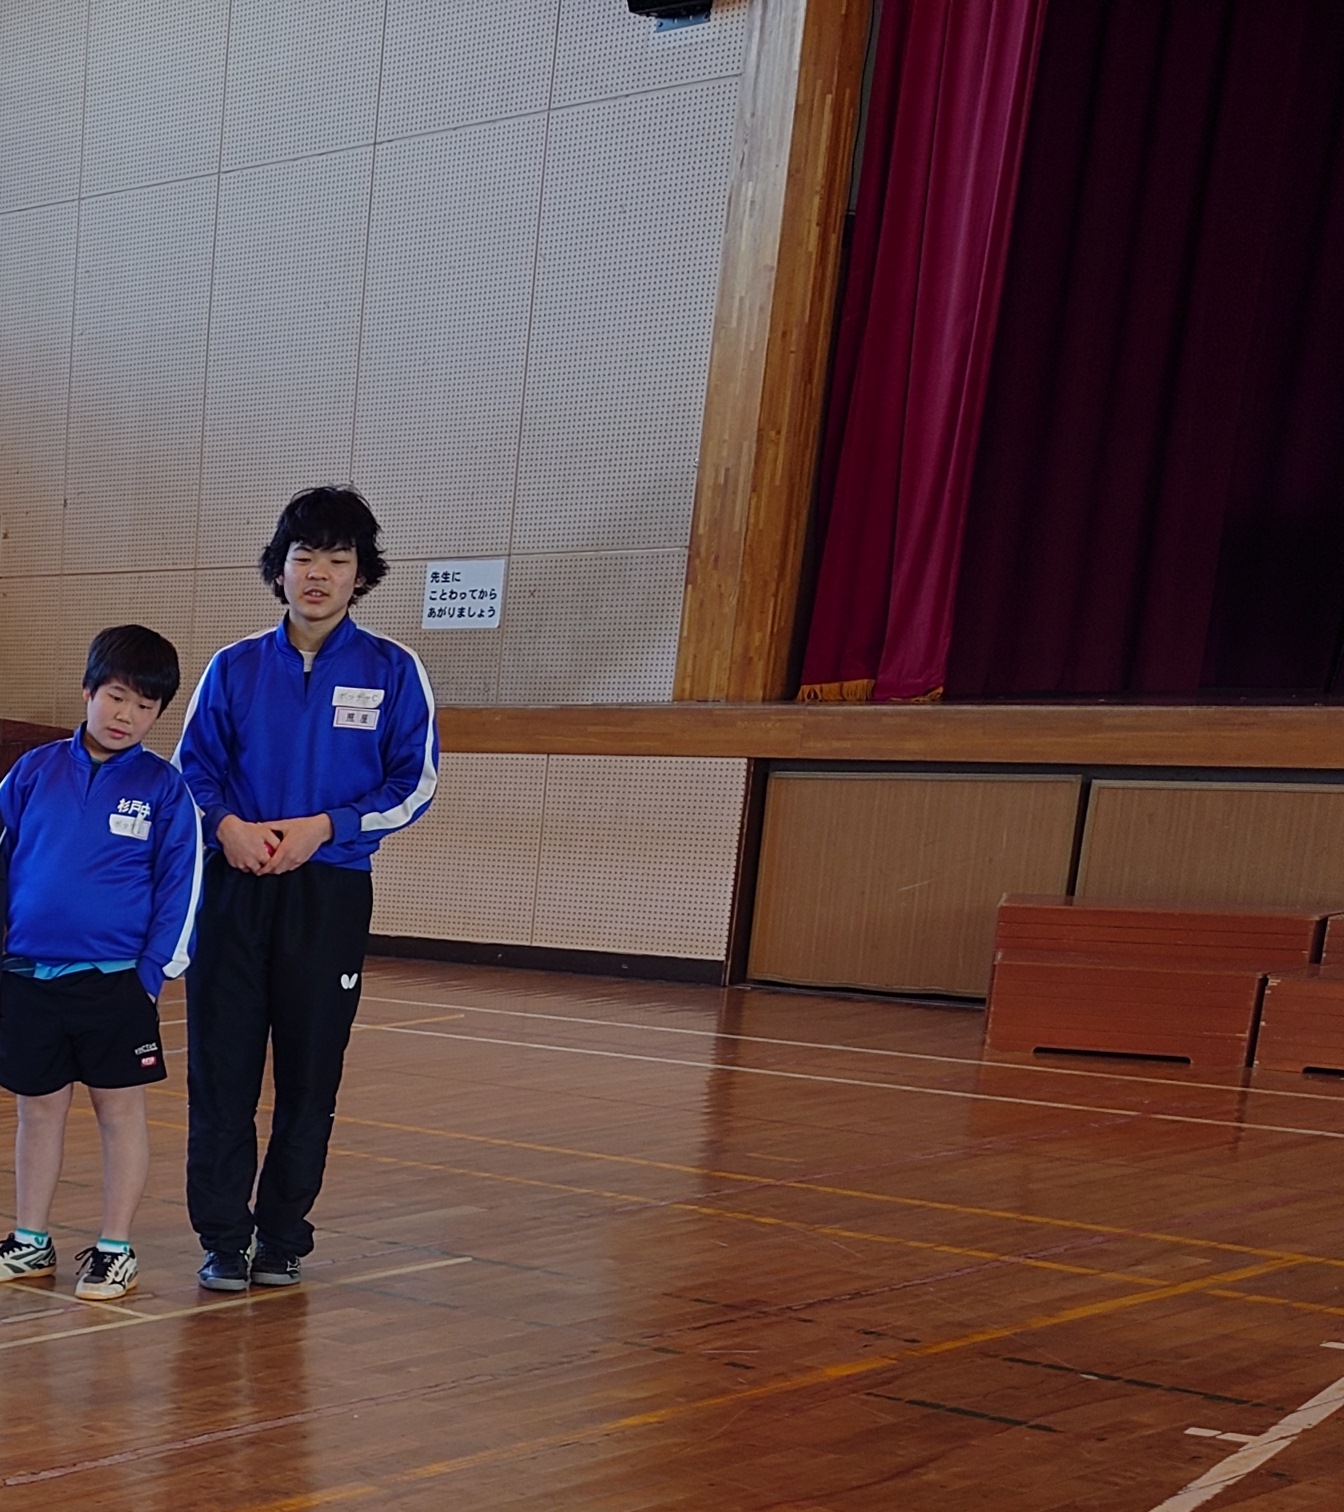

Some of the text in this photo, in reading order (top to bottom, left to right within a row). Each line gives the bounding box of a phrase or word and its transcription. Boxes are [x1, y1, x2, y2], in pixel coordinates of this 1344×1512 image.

[429, 571, 461, 584] 先生に
[428, 588, 497, 601] ことわってから
[427, 606, 496, 619] あがりましょう
